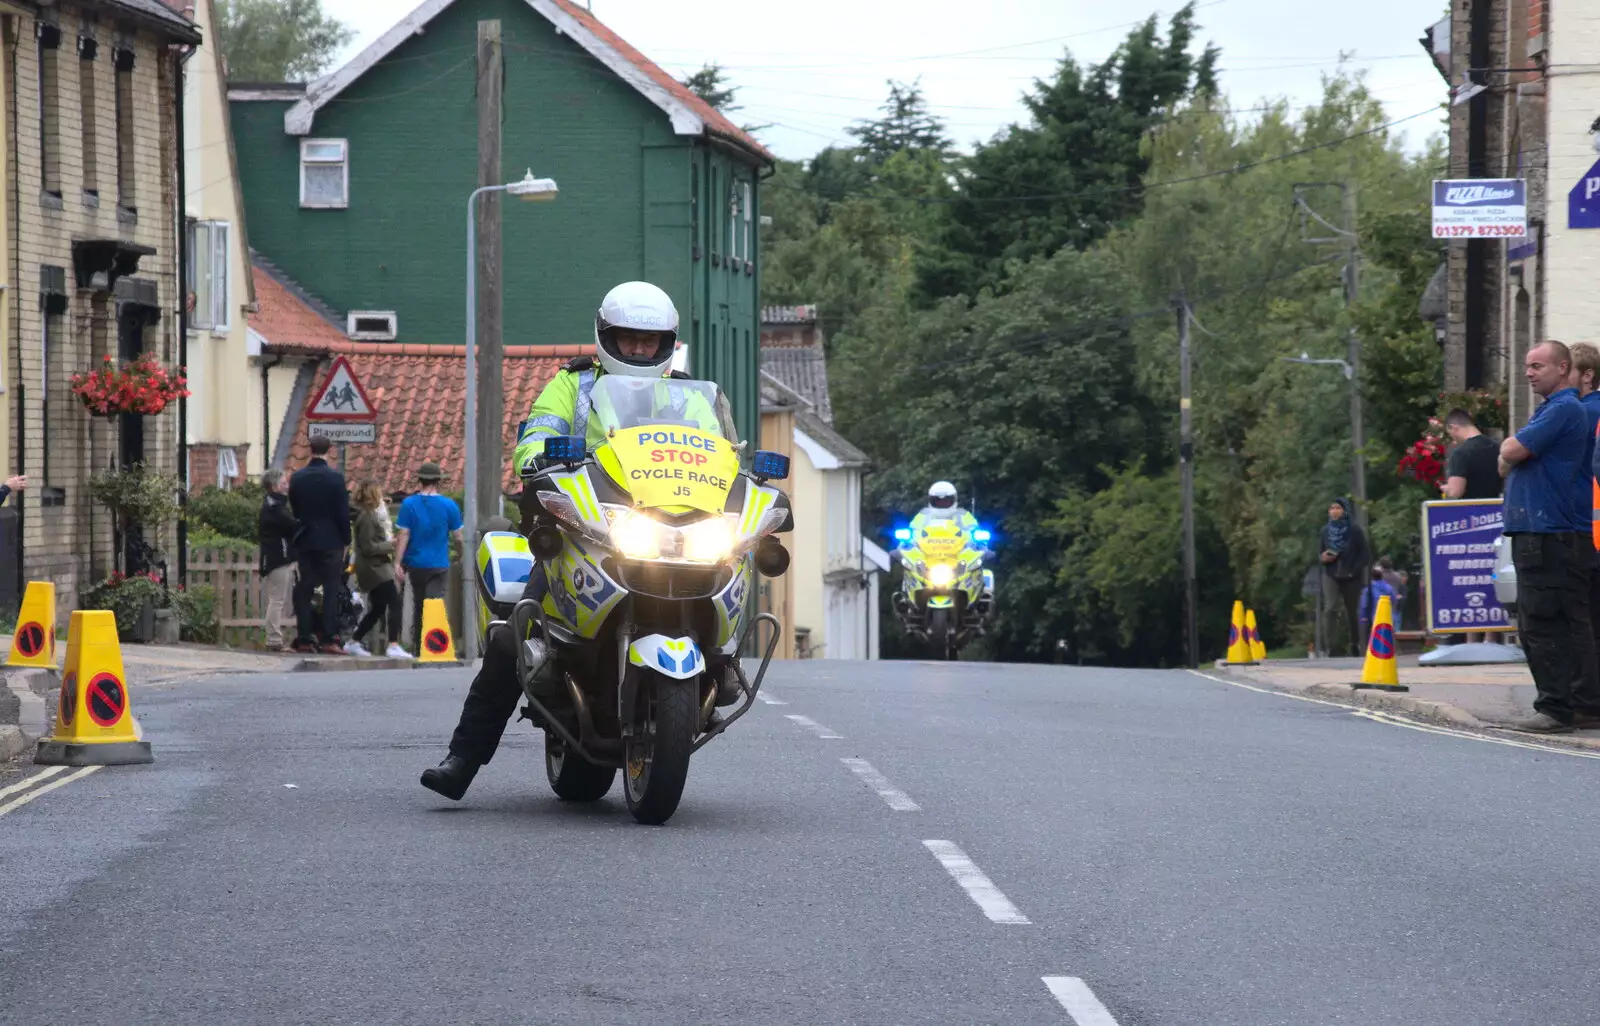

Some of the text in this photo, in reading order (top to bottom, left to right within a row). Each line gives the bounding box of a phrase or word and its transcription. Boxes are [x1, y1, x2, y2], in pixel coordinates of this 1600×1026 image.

[1435, 225, 1524, 236] 01379 873300
[313, 427, 371, 438] Playground
[638, 431, 716, 452] POLICE
[651, 449, 708, 466] STOP
[630, 469, 727, 491] CYCLE RACE
[673, 486, 691, 496] J5
[1432, 511, 1503, 538] pizza hous
[1436, 544, 1496, 554] FRIED CHIC
[1453, 576, 1493, 586] KEBAB
